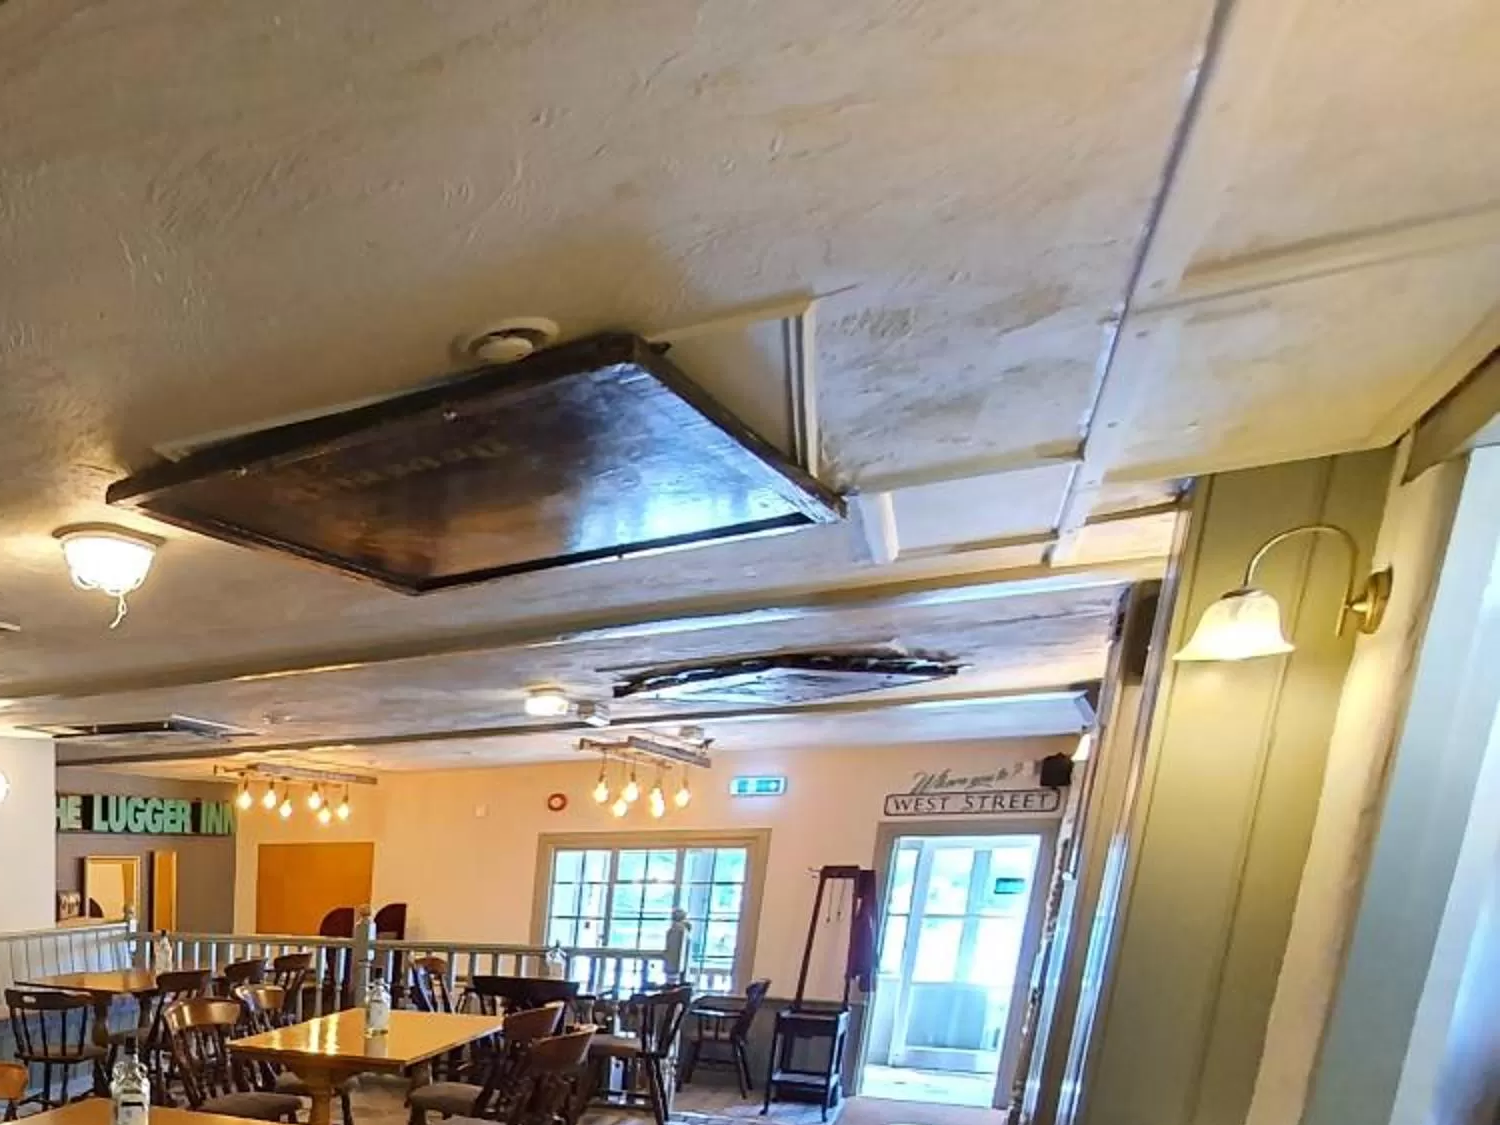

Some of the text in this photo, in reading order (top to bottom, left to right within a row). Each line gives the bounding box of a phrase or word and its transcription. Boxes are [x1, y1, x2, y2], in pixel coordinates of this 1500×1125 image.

[93, 794, 192, 834] LUGGER
[894, 794, 1048, 812] WEST STREET
